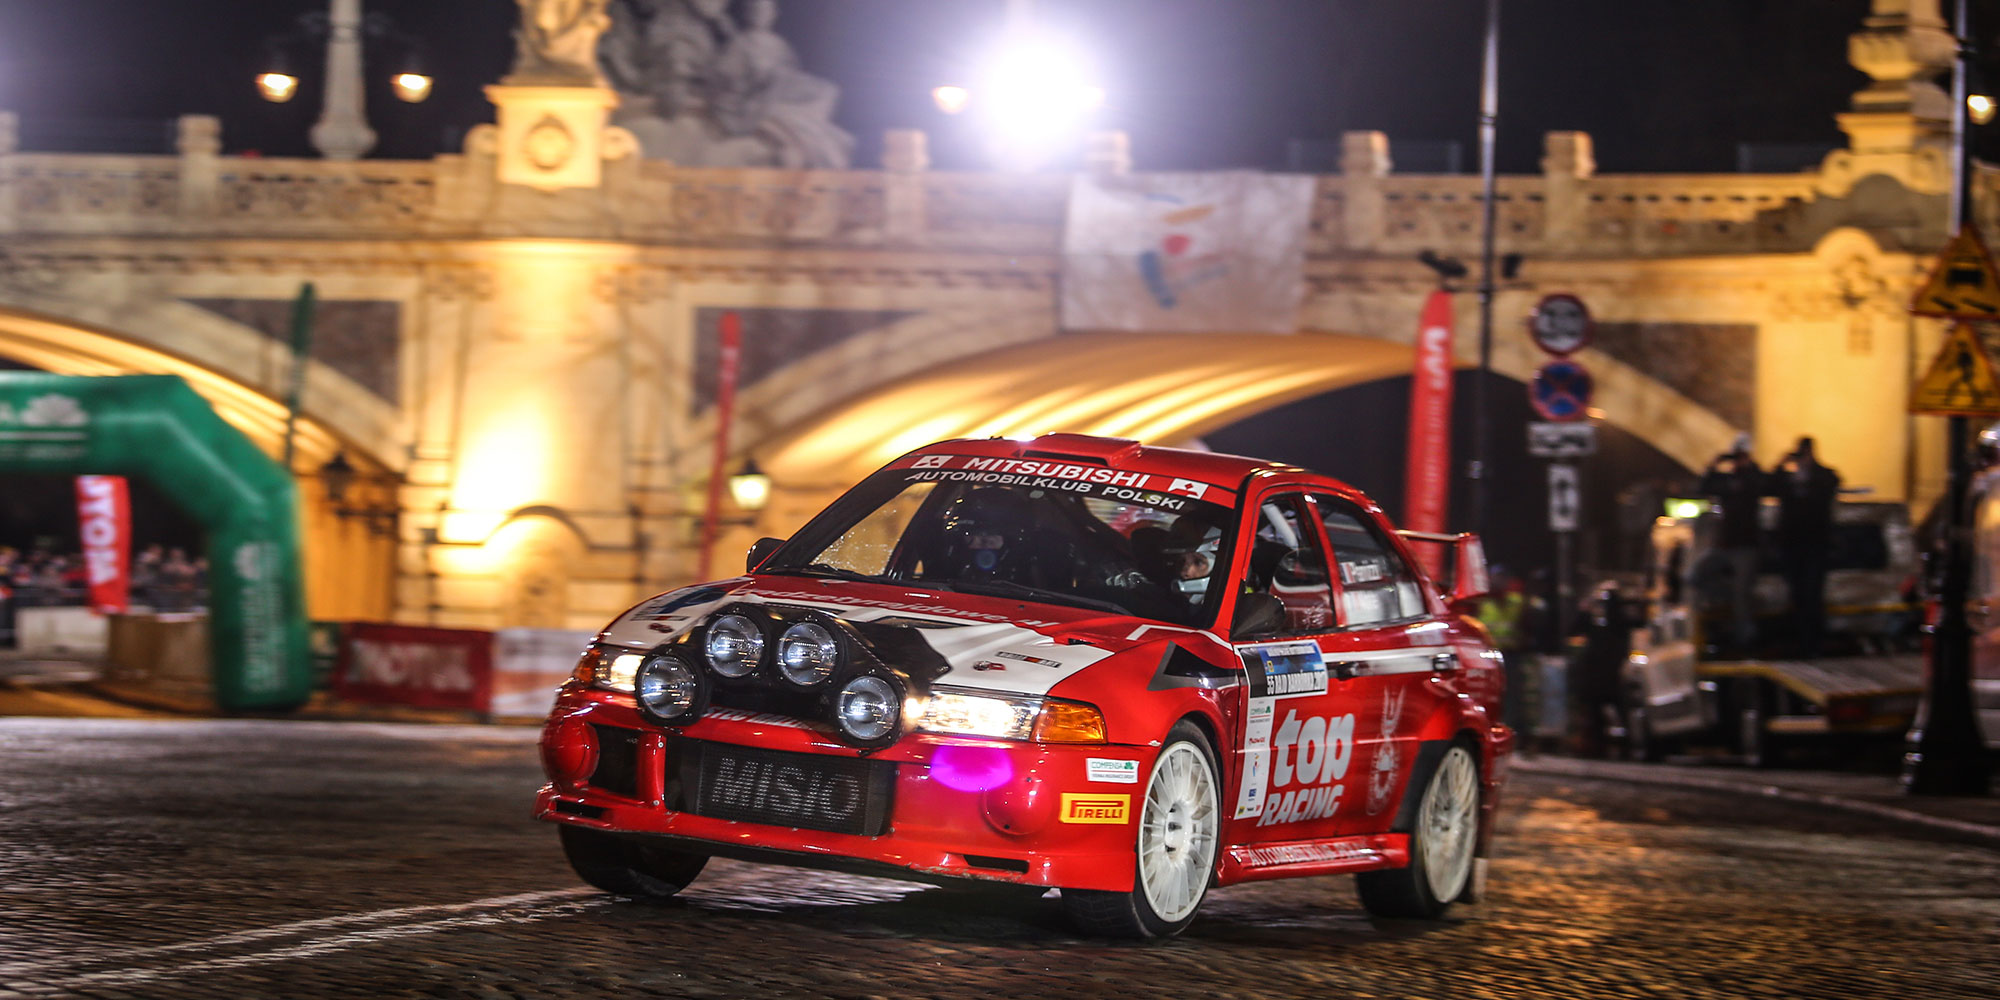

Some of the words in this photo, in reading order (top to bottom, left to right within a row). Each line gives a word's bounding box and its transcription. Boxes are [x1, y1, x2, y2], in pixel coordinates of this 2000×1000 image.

[904, 471, 1092, 493] AUTOMOBILKLUB
[1101, 486, 1186, 510] POLSKI
[962, 456, 1150, 488] MITSUBISHI
[1273, 709, 1355, 788] top
[710, 756, 860, 822] MISIO
[1256, 785, 1344, 827] RACING
[1069, 800, 1124, 819] PIRELLI
